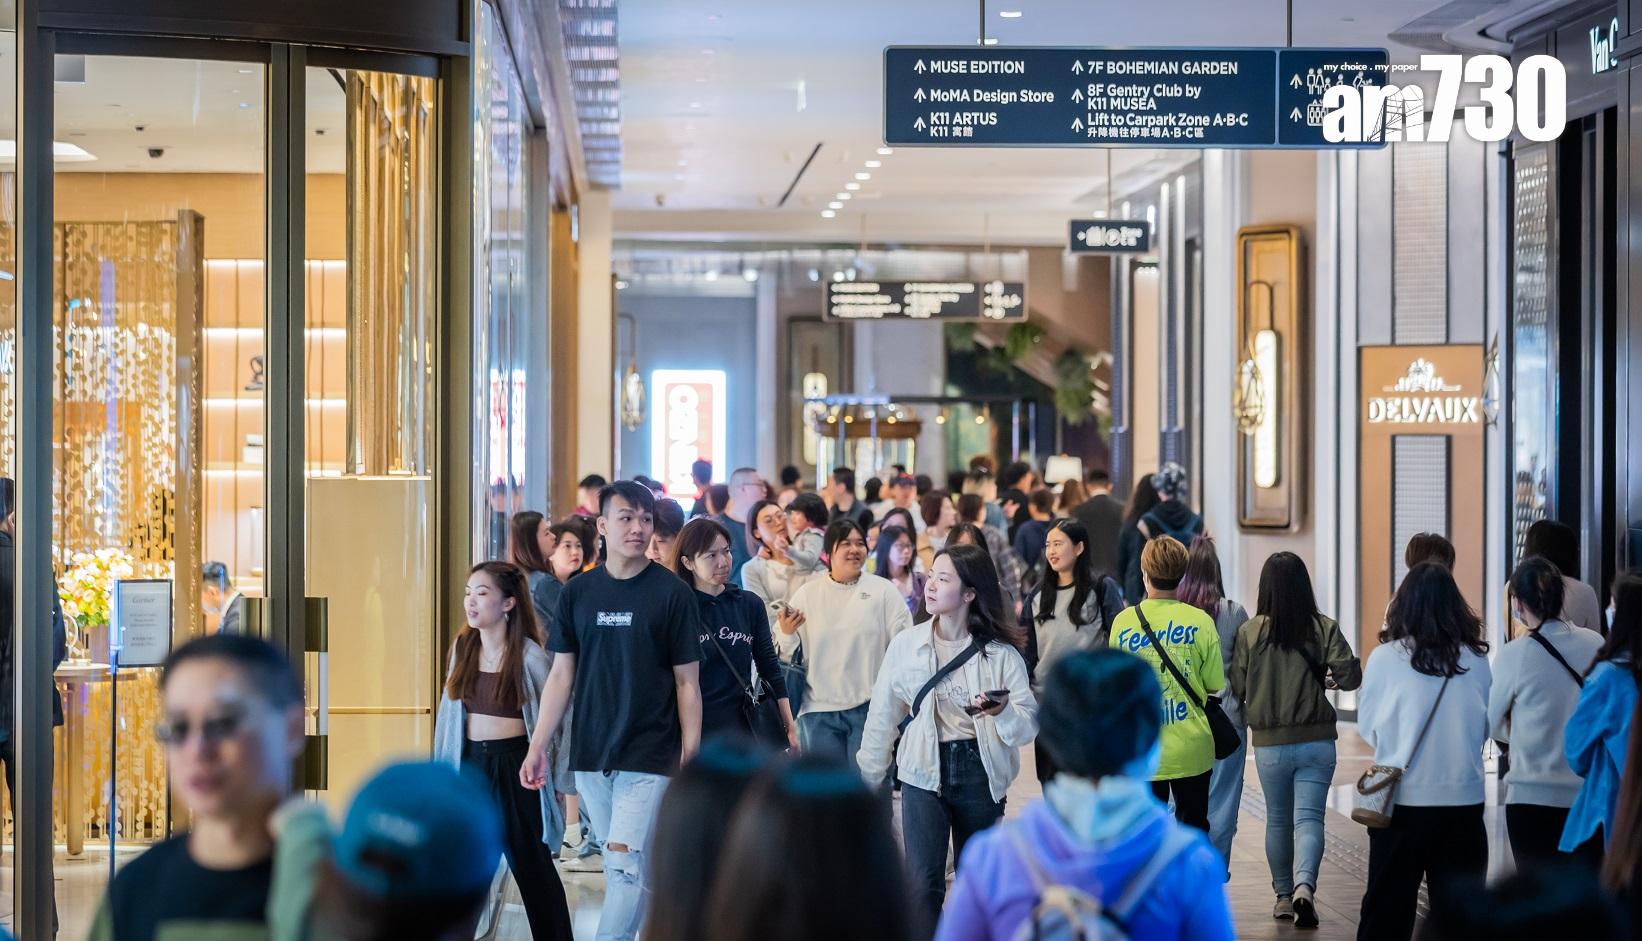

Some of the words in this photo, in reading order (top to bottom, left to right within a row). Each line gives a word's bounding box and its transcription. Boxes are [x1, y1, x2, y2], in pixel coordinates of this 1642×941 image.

[1589, 26, 1609, 74] Van
[930, 60, 967, 74] MUSE
[970, 60, 1025, 74] EDITION
[1088, 61, 1104, 74] 7F
[1106, 62, 1178, 74] BOHEMIAN
[1182, 62, 1238, 74] GARDEN
[930, 89, 970, 102] MoMA
[973, 88, 1018, 104] Design
[1020, 89, 1054, 102] Store
[1088, 84, 1104, 96] 8F
[1106, 84, 1150, 99] Gentry
[1154, 84, 1182, 97] Club
[1186, 84, 1202, 99] by
[1088, 98, 1107, 110] K11
[1110, 98, 1156, 110] MUSEA
[930, 112, 950, 124] K11
[952, 112, 998, 125] ARTUS
[1088, 113, 1109, 126] Lift
[1111, 114, 1124, 126] to
[1126, 113, 1176, 127] Carpark
[1178, 114, 1210, 126] Zone
[930, 126, 948, 136] K11
[1368, 396, 1480, 424] DELVAUX
[598, 613, 632, 625] Supreme
